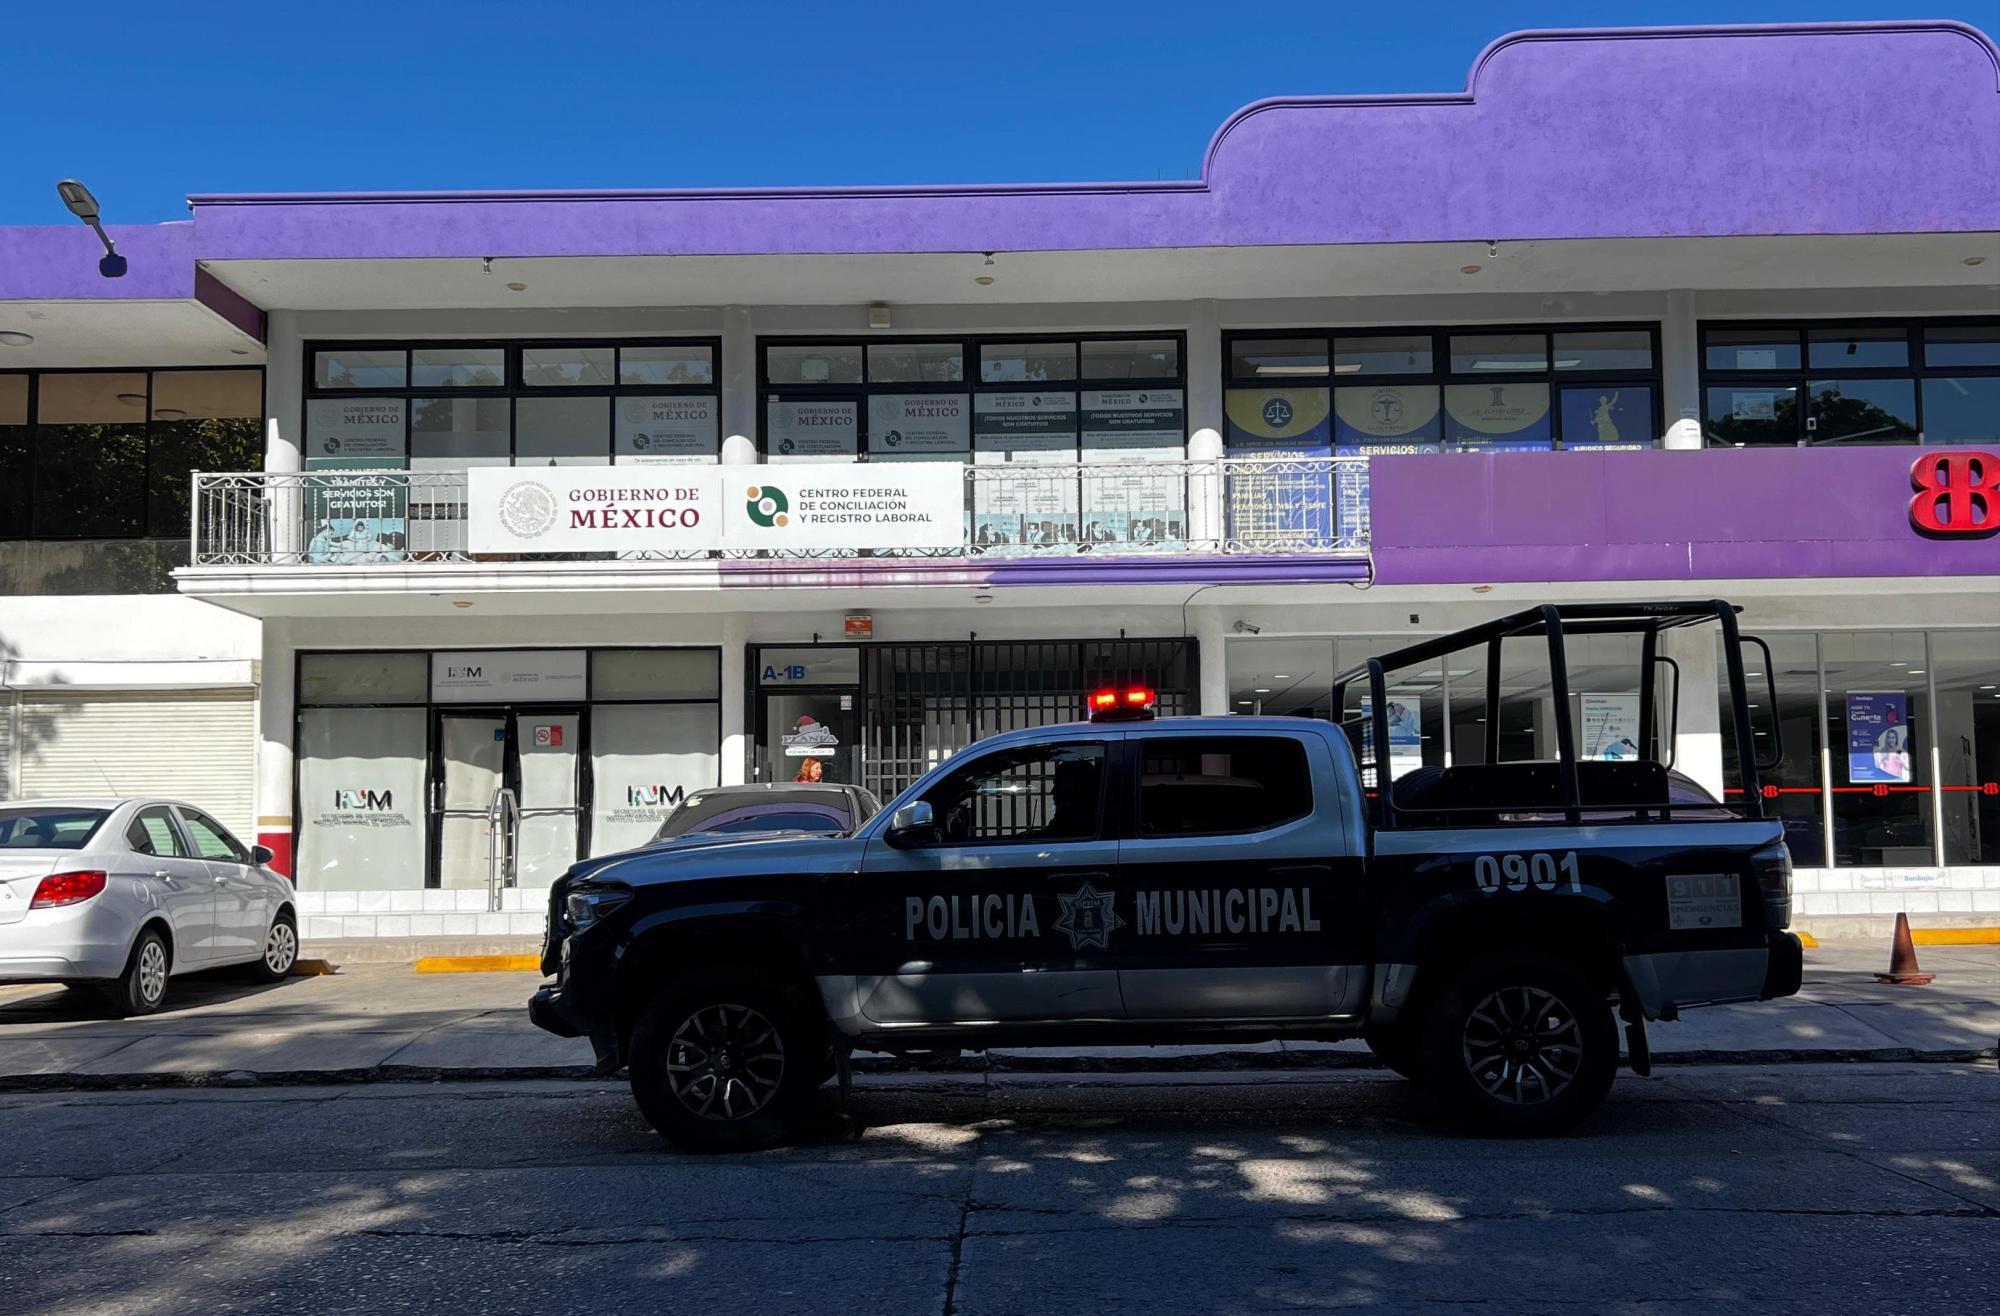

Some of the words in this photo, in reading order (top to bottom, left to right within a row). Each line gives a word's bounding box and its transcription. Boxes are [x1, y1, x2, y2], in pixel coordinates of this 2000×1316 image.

[653, 408, 707, 420] MÉXICO
[905, 406, 959, 417] MÉXICO
[344, 413, 399, 424] MÉXICO
[798, 414, 853, 426] MÉXICO
[1359, 445, 1418, 455] SERVICIOS:
[322, 489, 372, 498] SERVICIOS
[374, 489, 395, 497] SON
[569, 488, 669, 501] GOBIERNO
[675, 488, 699, 501] DE
[799, 488, 849, 498] CENTRO
[853, 488, 908, 498] FEDERAL
[330, 500, 386, 508] GRATUITOS!
[800, 502, 816, 510] DE
[820, 498, 907, 510] CONCILIACIÓN
[569, 503, 700, 528] MÉXICO
[800, 514, 808, 523] Y
[811, 514, 872, 523] REGISTRO
[876, 513, 932, 523] LABORAL
[762, 666, 805, 681] A-1B
[1475, 851, 1582, 893] 0901
[906, 894, 1040, 940] POLICIA
[1136, 887, 1321, 935] MUNICIPAL
